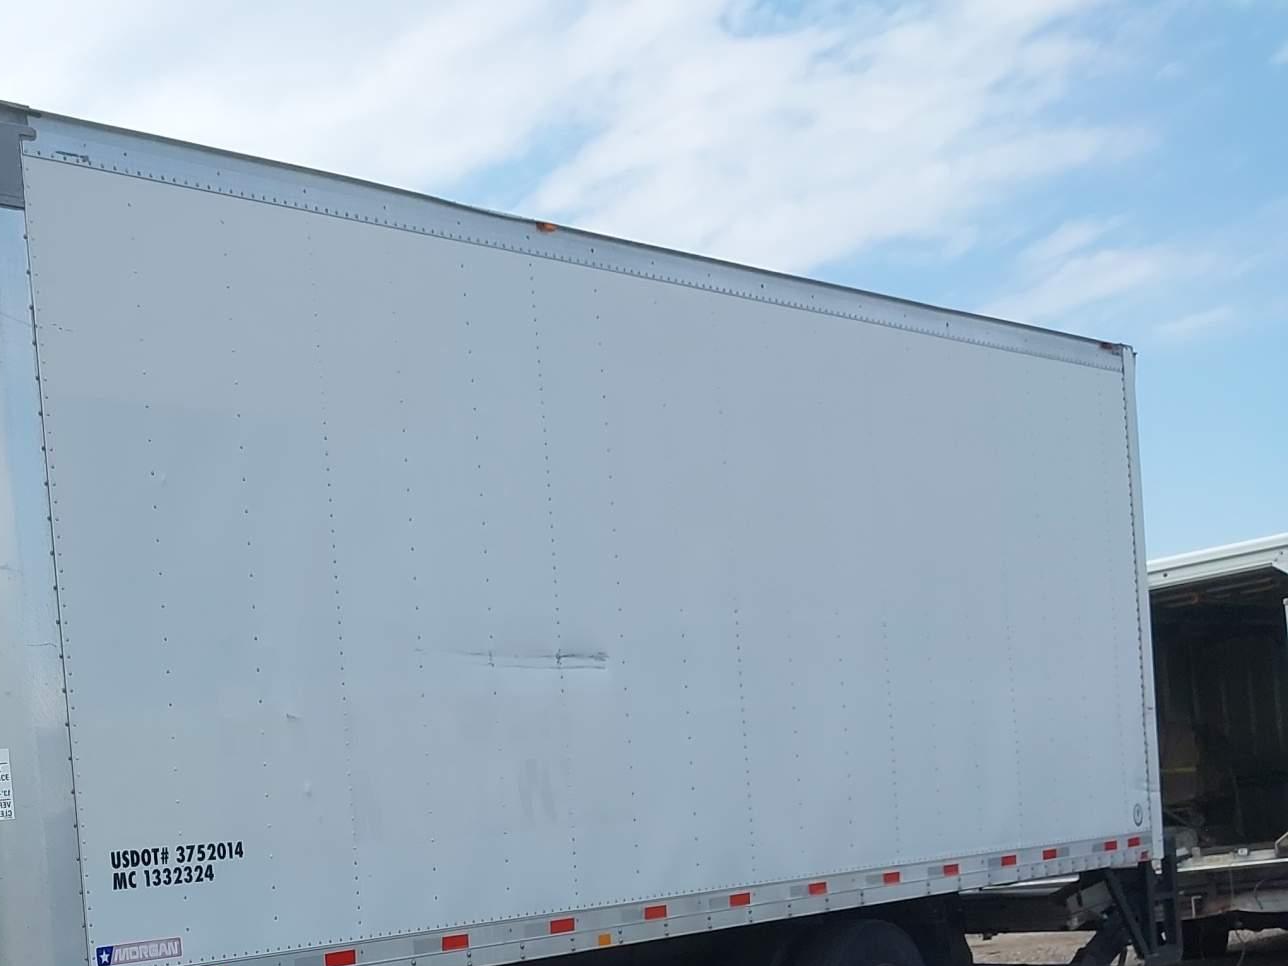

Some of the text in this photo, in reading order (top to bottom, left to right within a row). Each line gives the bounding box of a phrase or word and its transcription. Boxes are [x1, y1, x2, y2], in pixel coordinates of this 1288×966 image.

[111, 841, 244, 869] USDOT# 3752014
[113, 864, 215, 890] MC 1332324
[114, 941, 180, 962] MORGAN
